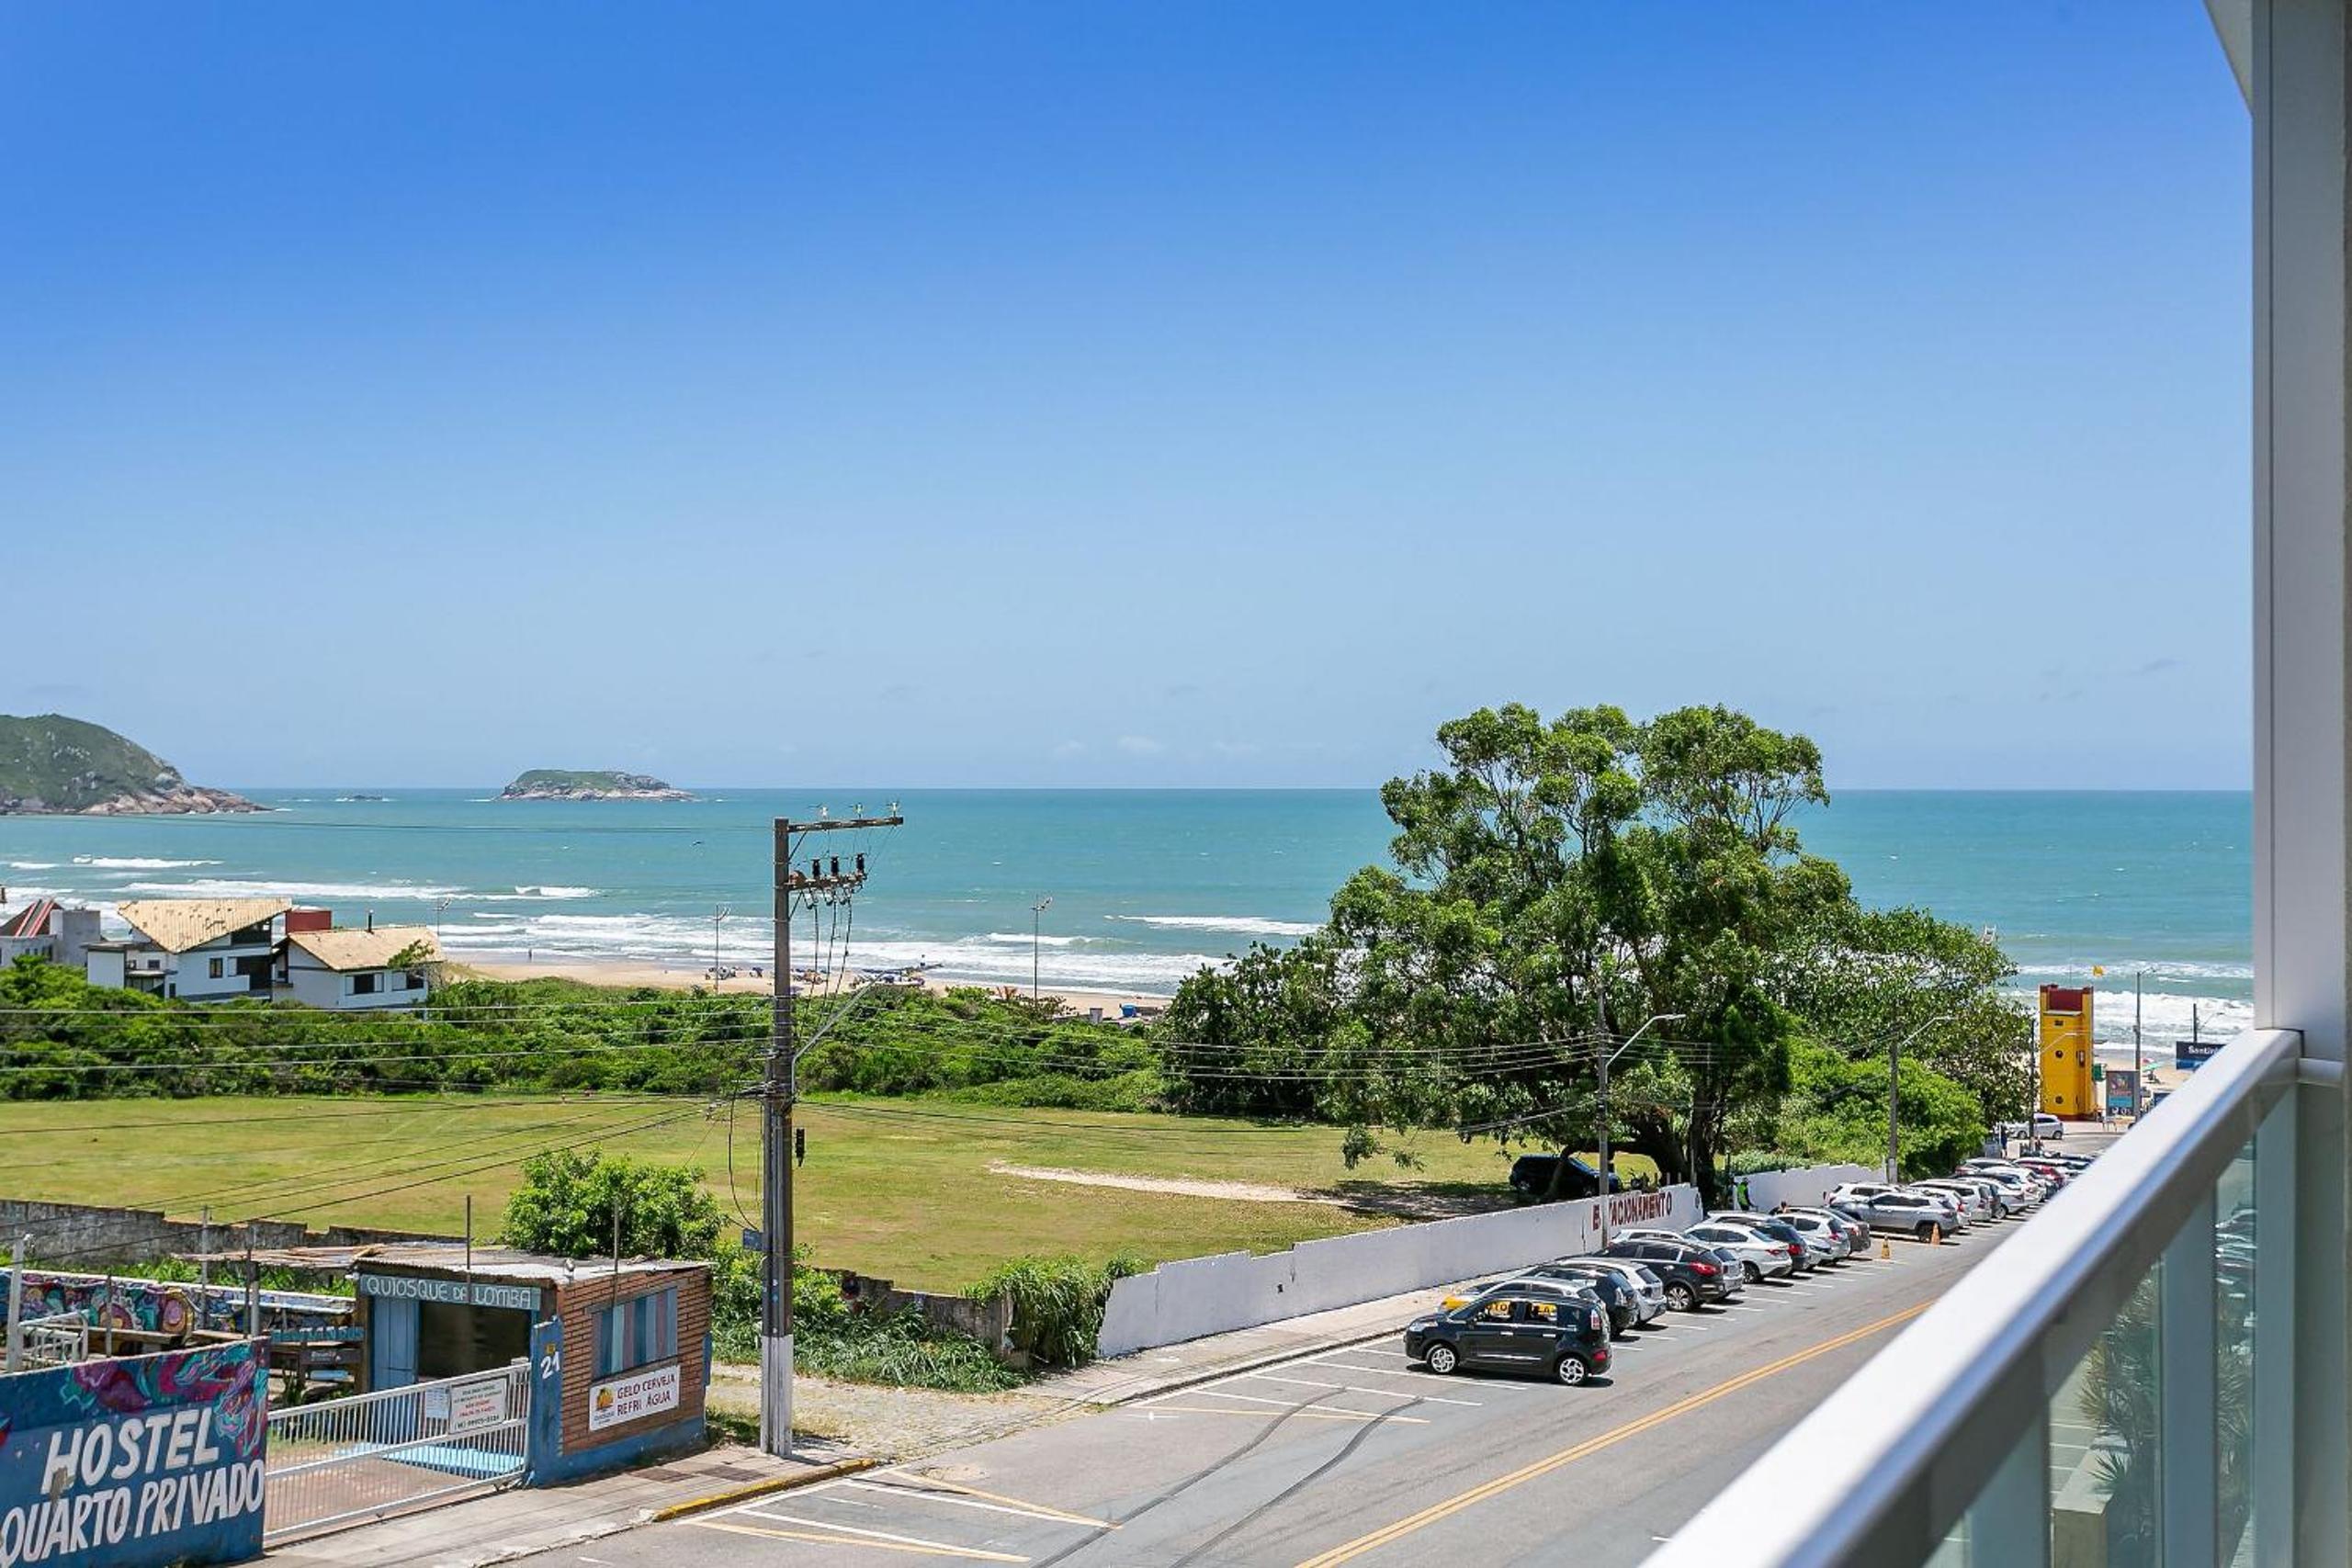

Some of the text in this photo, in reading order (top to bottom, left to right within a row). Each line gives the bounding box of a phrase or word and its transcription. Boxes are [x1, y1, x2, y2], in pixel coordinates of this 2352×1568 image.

[368, 1277, 448, 1302] QUIOSQUE
[475, 1287, 531, 1308] LOMBA
[616, 1374, 675, 1399] GELO CERVEJA
[616, 1399, 641, 1416] REFRI
[40, 1407, 220, 1495] HOSTEL
[0, 1459, 265, 1568] QUARTO PRIVADO
